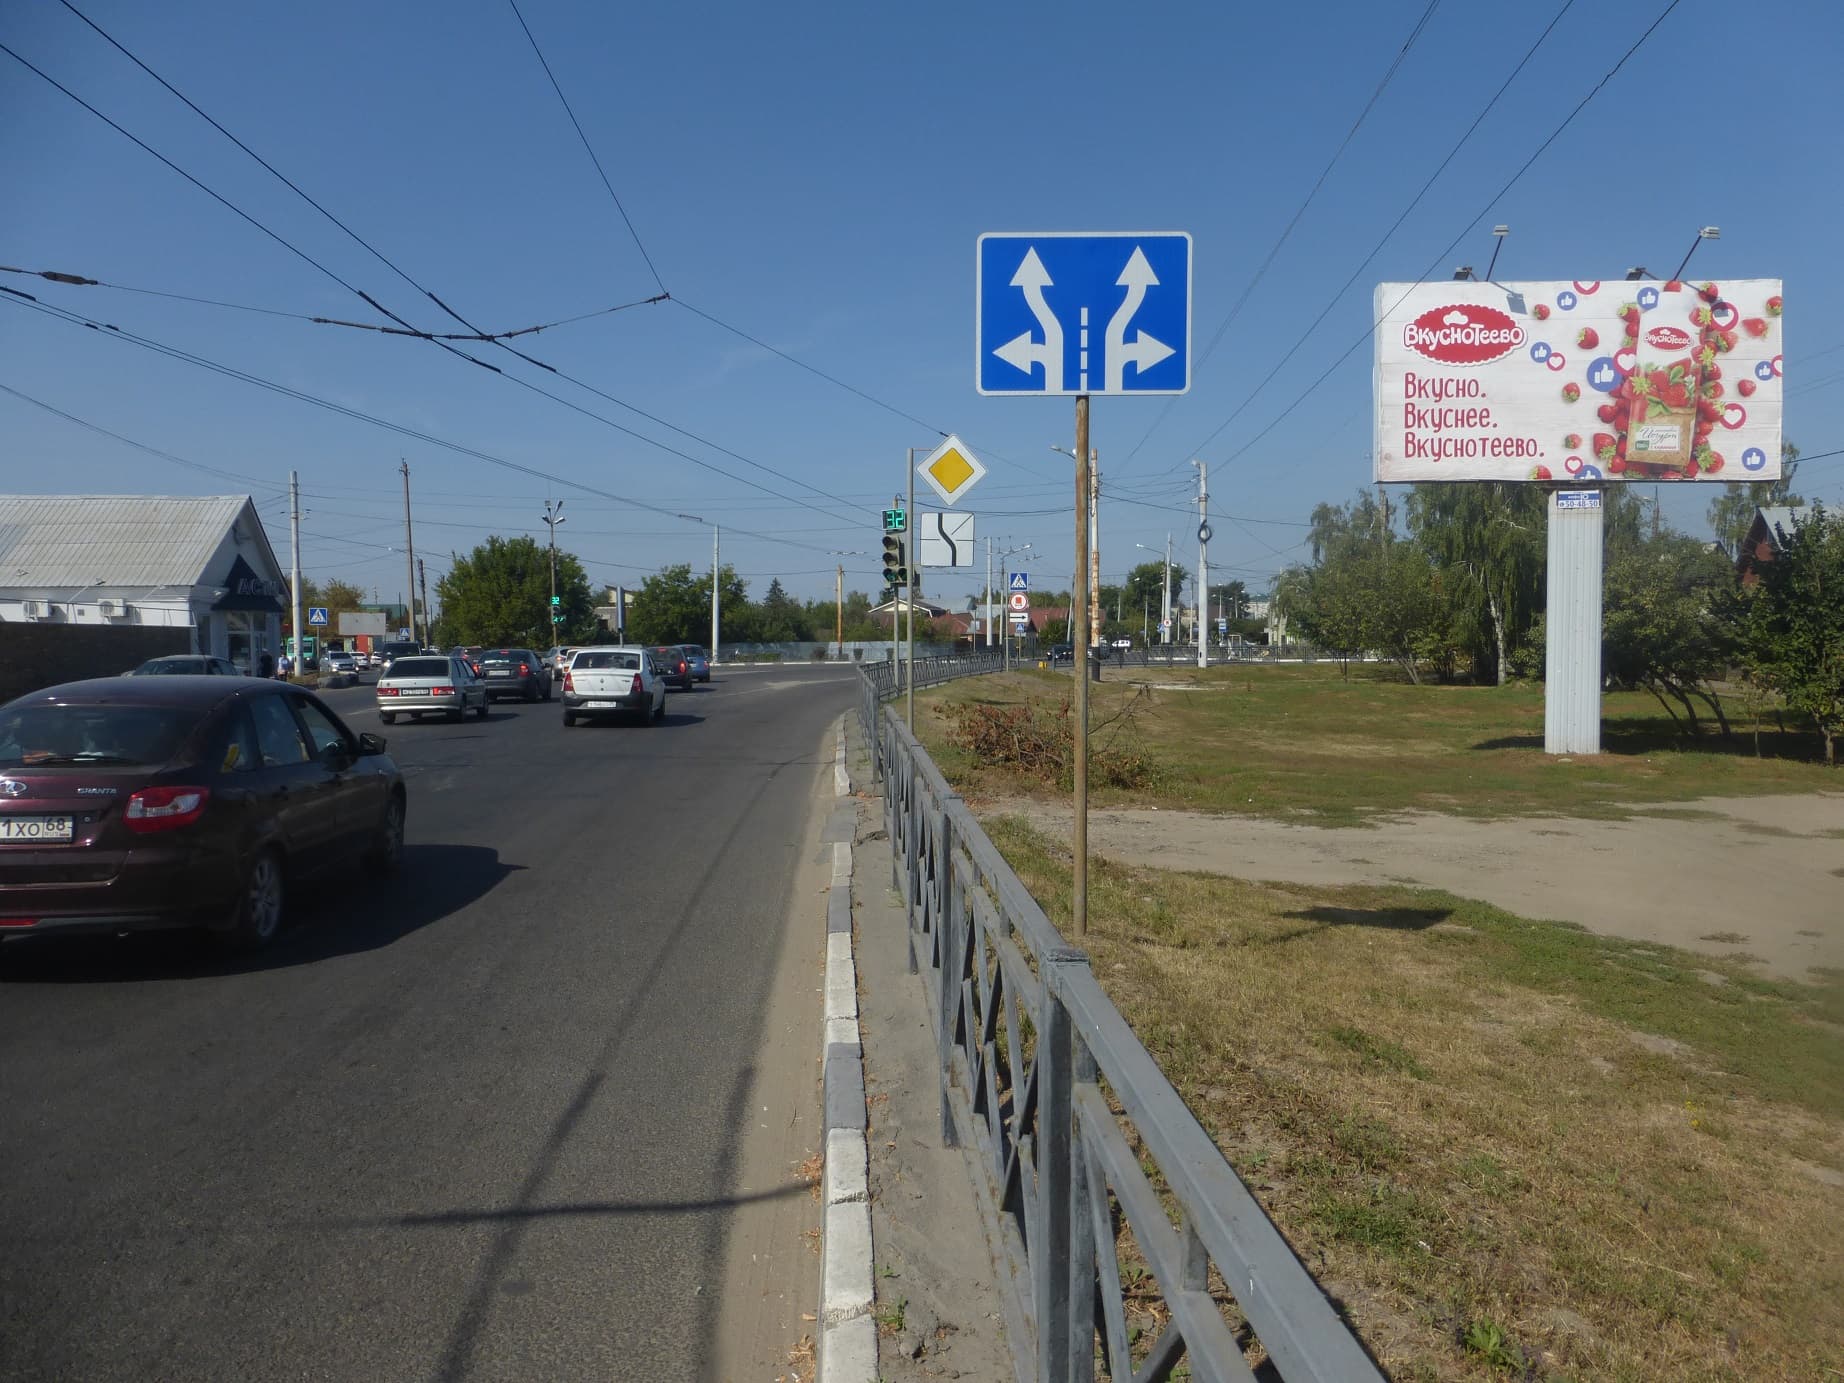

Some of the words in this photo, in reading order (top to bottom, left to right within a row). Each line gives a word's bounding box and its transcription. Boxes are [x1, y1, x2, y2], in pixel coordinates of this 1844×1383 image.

[1404, 372, 1487, 403] Вкусно.
[1404, 402, 1498, 433] Вкуснее.
[1404, 431, 1545, 462] Вкуснотеево.
[886, 509, 905, 529] 32
[45, 817, 66, 832] 68
